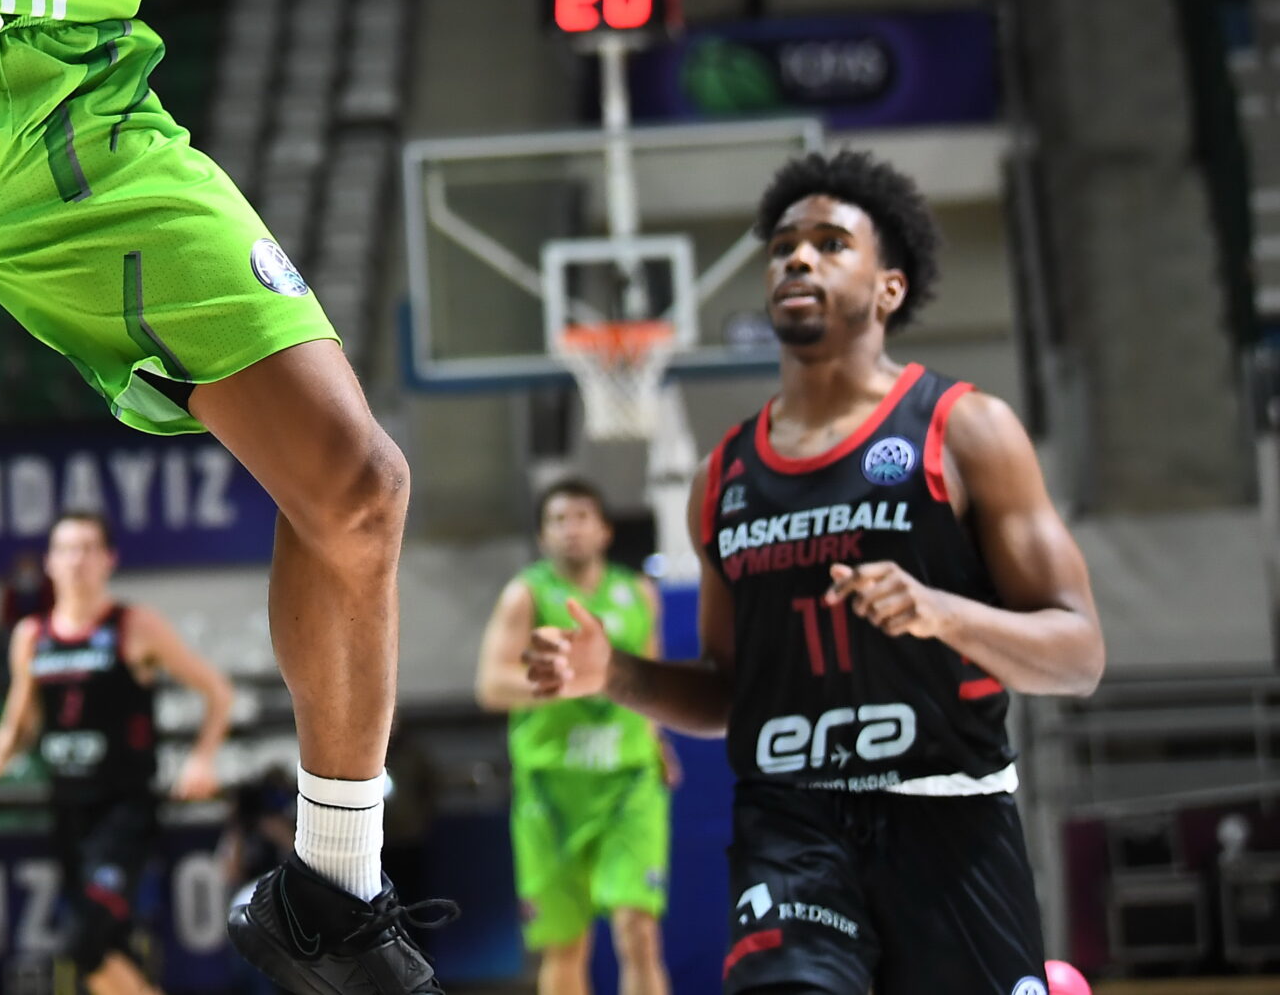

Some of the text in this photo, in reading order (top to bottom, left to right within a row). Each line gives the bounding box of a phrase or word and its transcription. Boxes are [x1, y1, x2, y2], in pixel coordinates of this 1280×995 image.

[719, 501, 913, 558] BASKETBALL
[792, 596, 852, 676] 11
[756, 703, 916, 774] era
[778, 902, 859, 940] REDSIDE
